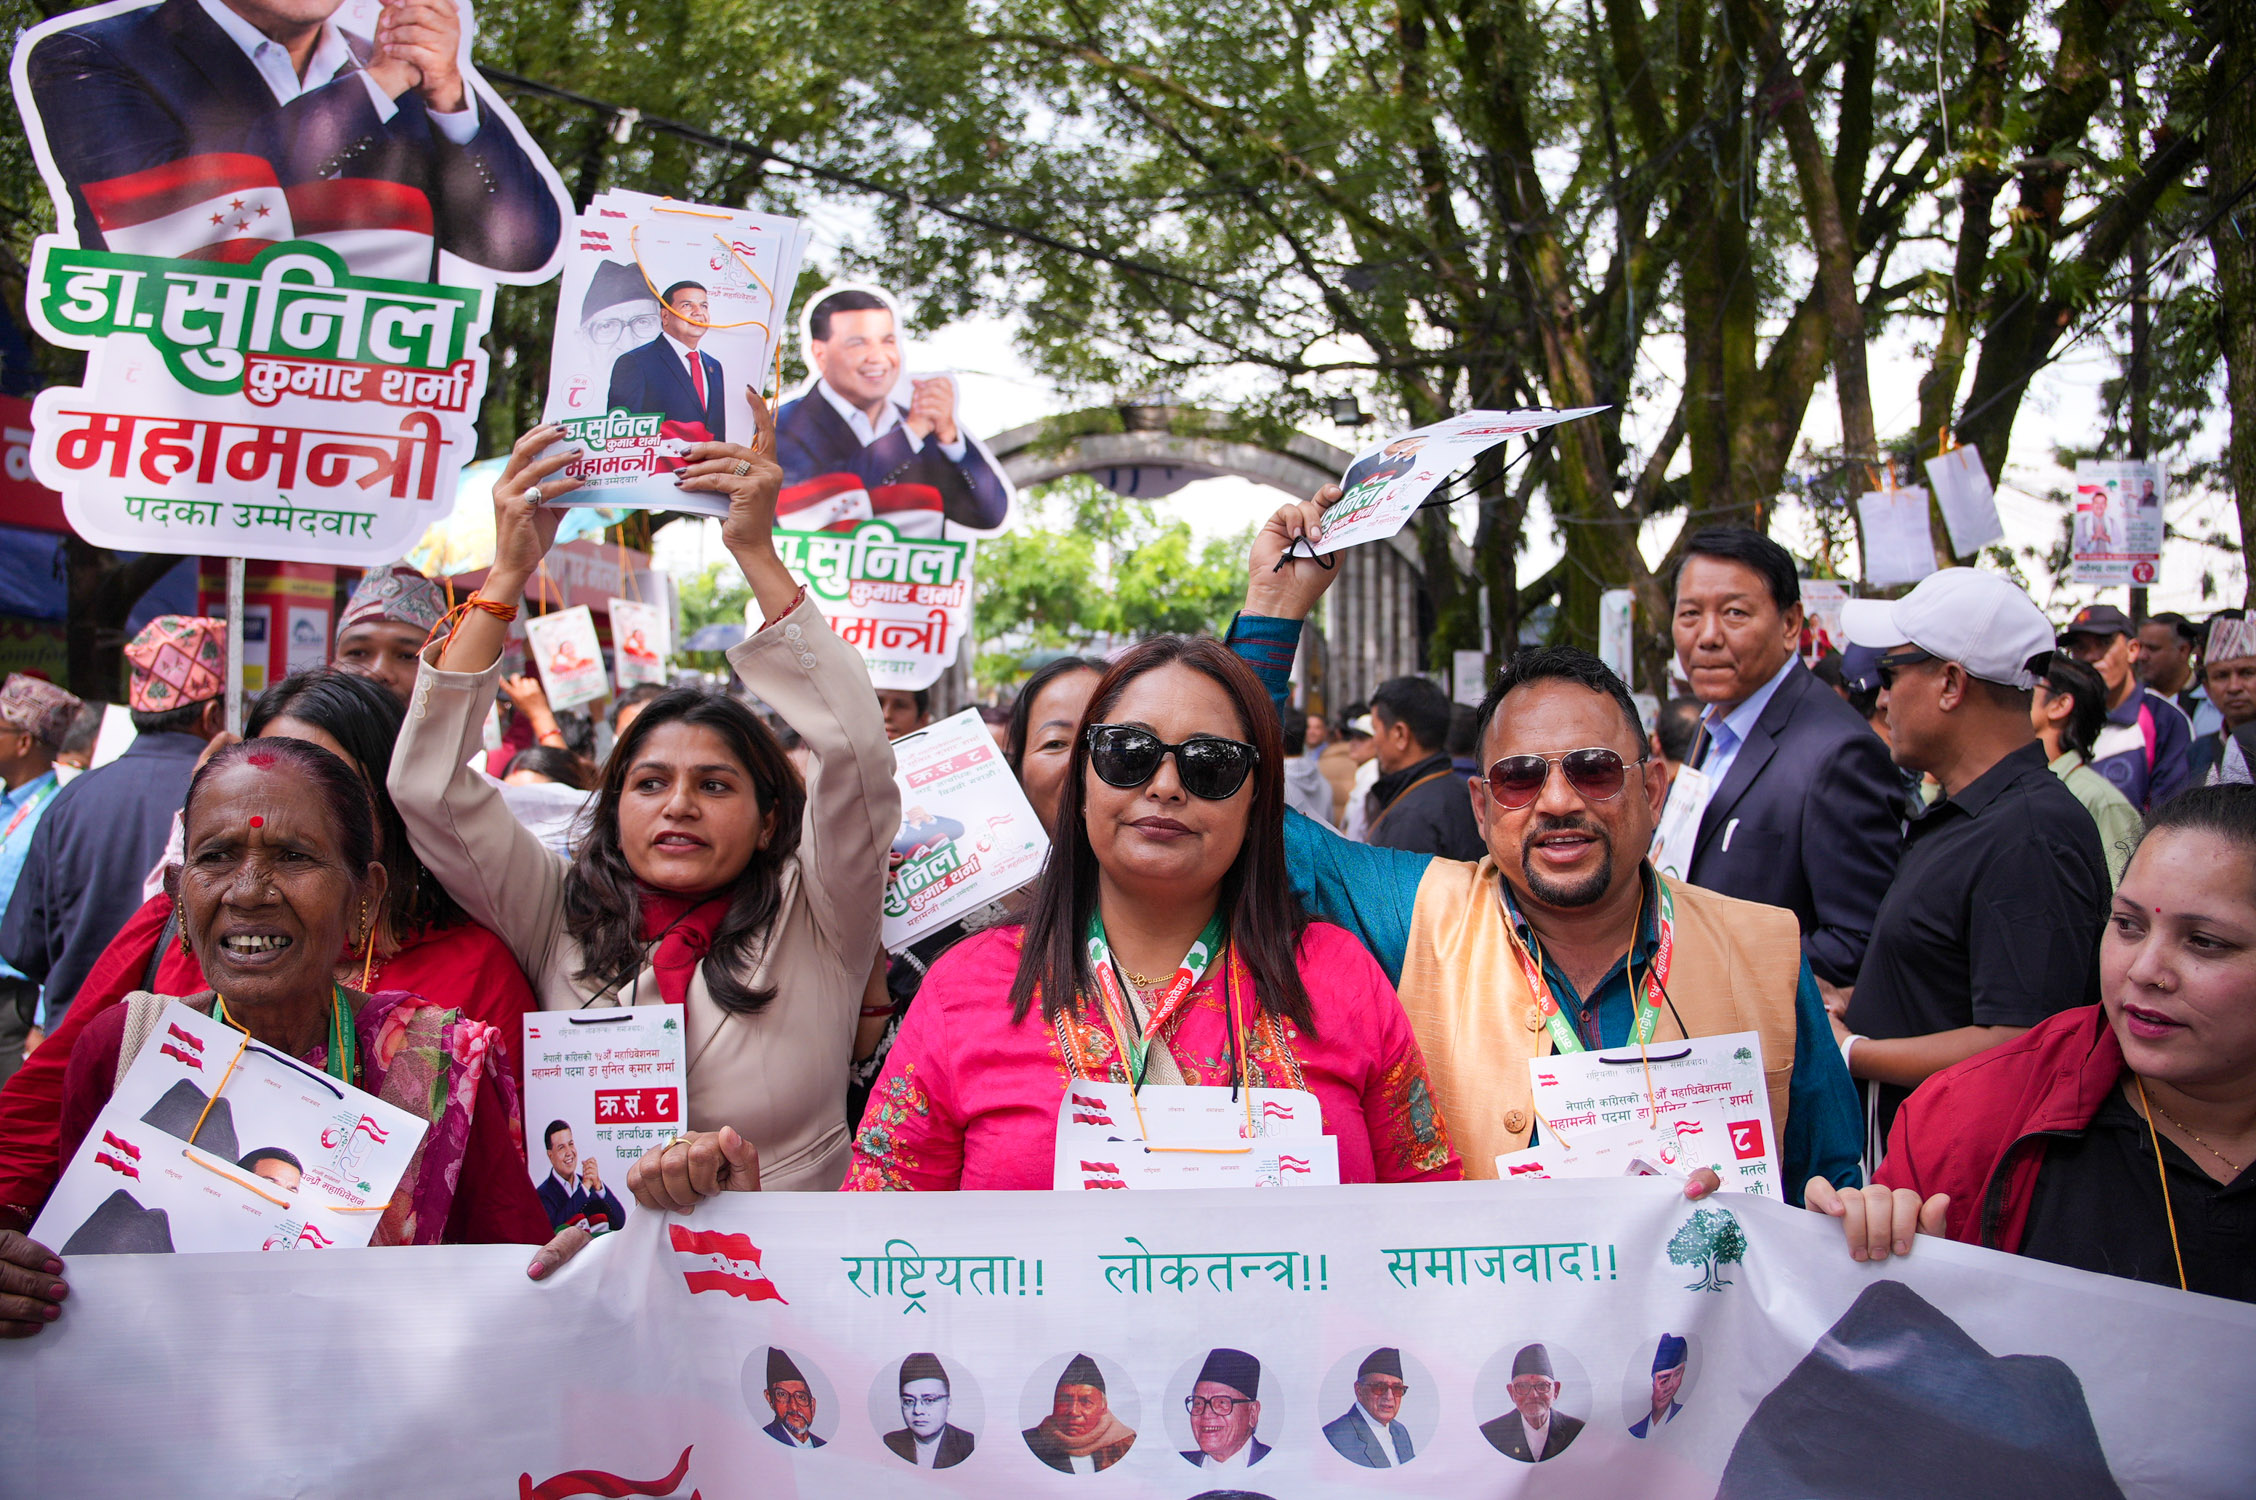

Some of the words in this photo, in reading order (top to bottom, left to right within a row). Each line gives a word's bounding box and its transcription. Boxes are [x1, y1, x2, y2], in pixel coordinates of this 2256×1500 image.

[249, 358, 371, 401] कुमार
[380, 364, 473, 409] शर्मा
[56, 409, 454, 501] महामन्त्री
[606, 438, 636, 452] कुमार
[638, 433, 662, 447] शर्मा
[565, 447, 659, 478] महामन्त्री
[124, 496, 222, 528] पदका
[232, 494, 378, 540] उम्मेदवार
[851, 582, 909, 605] कुमार
[914, 581, 965, 606] शर्मा
[910, 879, 950, 911] कुमार
[950, 855, 982, 884] शर्मा
[565, 1066, 585, 1078] पदमा
[588, 1066, 598, 1077] डा
[601, 1061, 625, 1079] सुनिल
[629, 1063, 652, 1077] कुमार
[656, 1059, 676, 1073] शर्मा
[1549, 1111, 1597, 1133] महामन्त्री
[1601, 1109, 1632, 1124] पदमा
[1635, 1107, 1650, 1121] डा
[1729, 1089, 1754, 1107] शर्मा
[1566, 1097, 1595, 1112] नेपाली
[1671, 1081, 1732, 1098] महाधिवेशनमा
[616, 1125, 653, 1141] अत्यधिक
[1739, 1161, 1767, 1177] मतले
[841, 1239, 1043, 1314] राष्ट्रियता!!
[1098, 1236, 1328, 1293] लोकतन्त्र!!
[1380, 1242, 1617, 1289] समाजवाद!!
